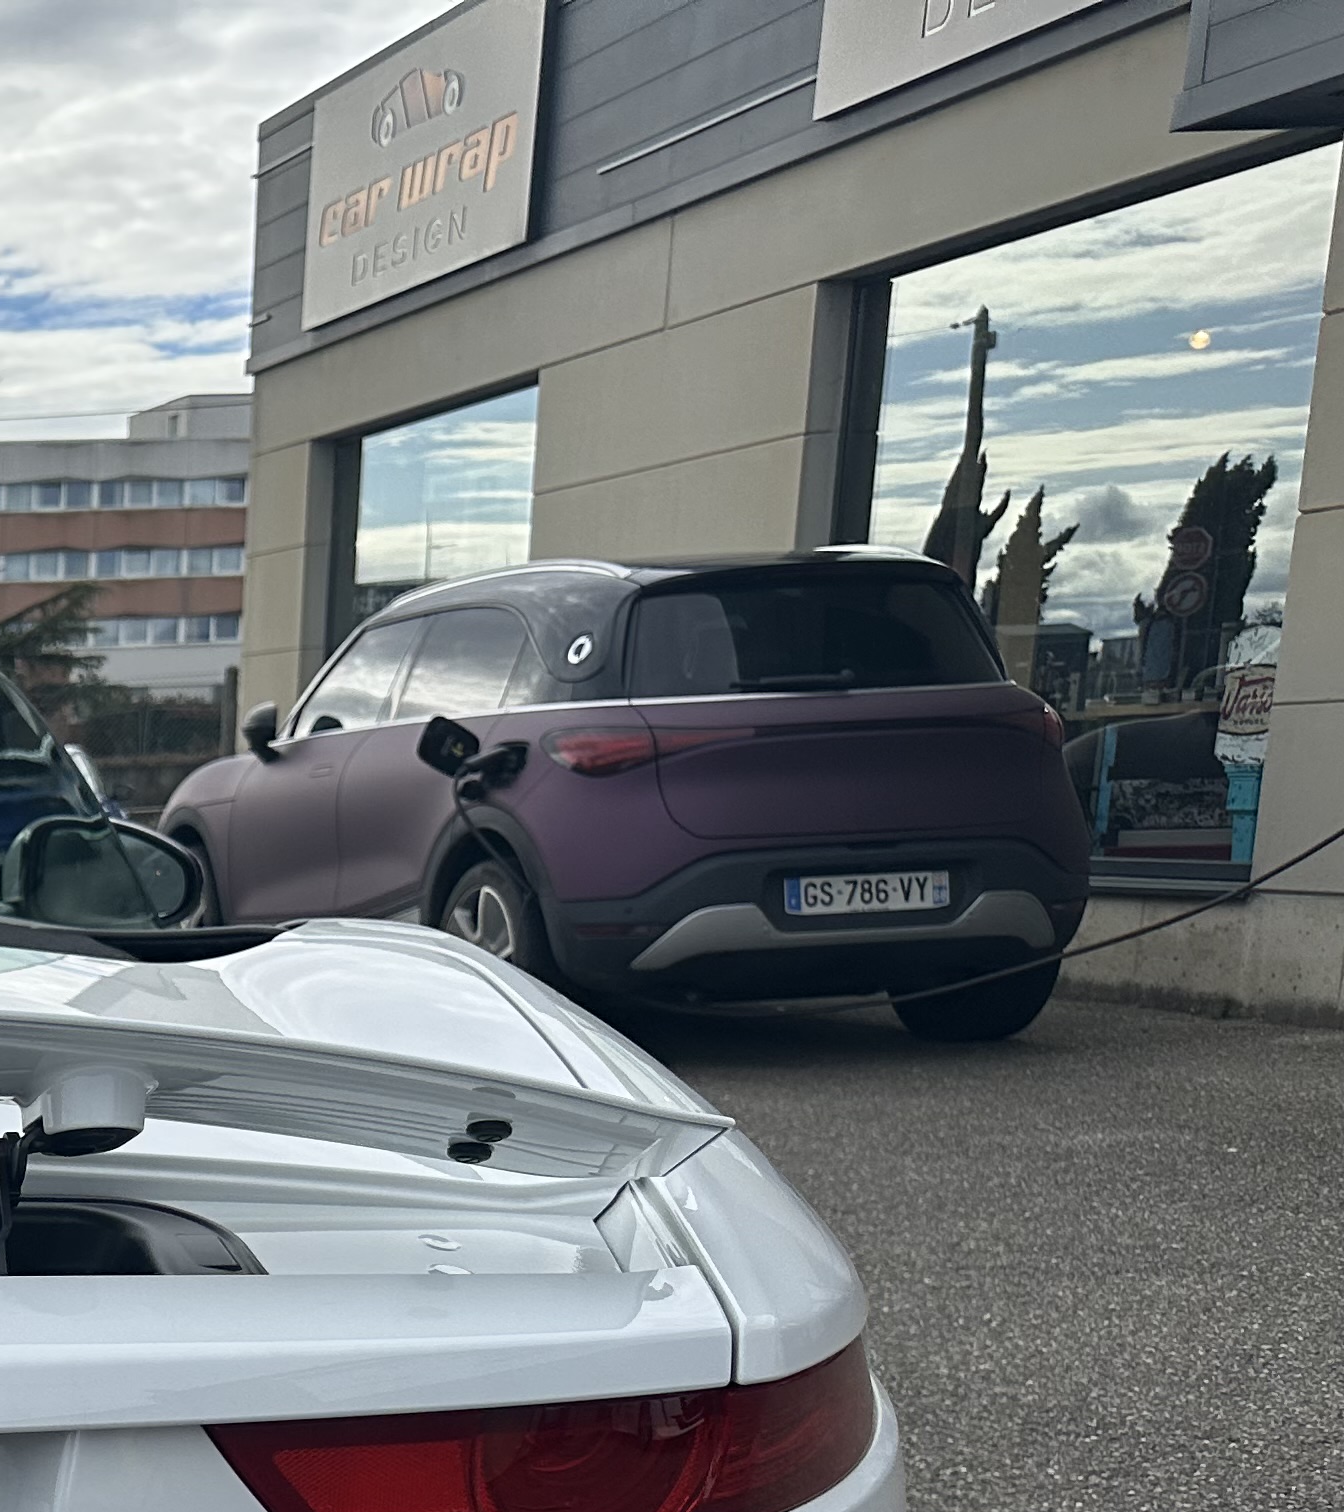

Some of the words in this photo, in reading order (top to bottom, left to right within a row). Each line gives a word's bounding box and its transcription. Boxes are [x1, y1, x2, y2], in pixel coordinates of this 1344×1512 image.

[319, 176, 393, 247] car
[397, 110, 519, 211] wrap
[351, 205, 467, 286] DESIGN
